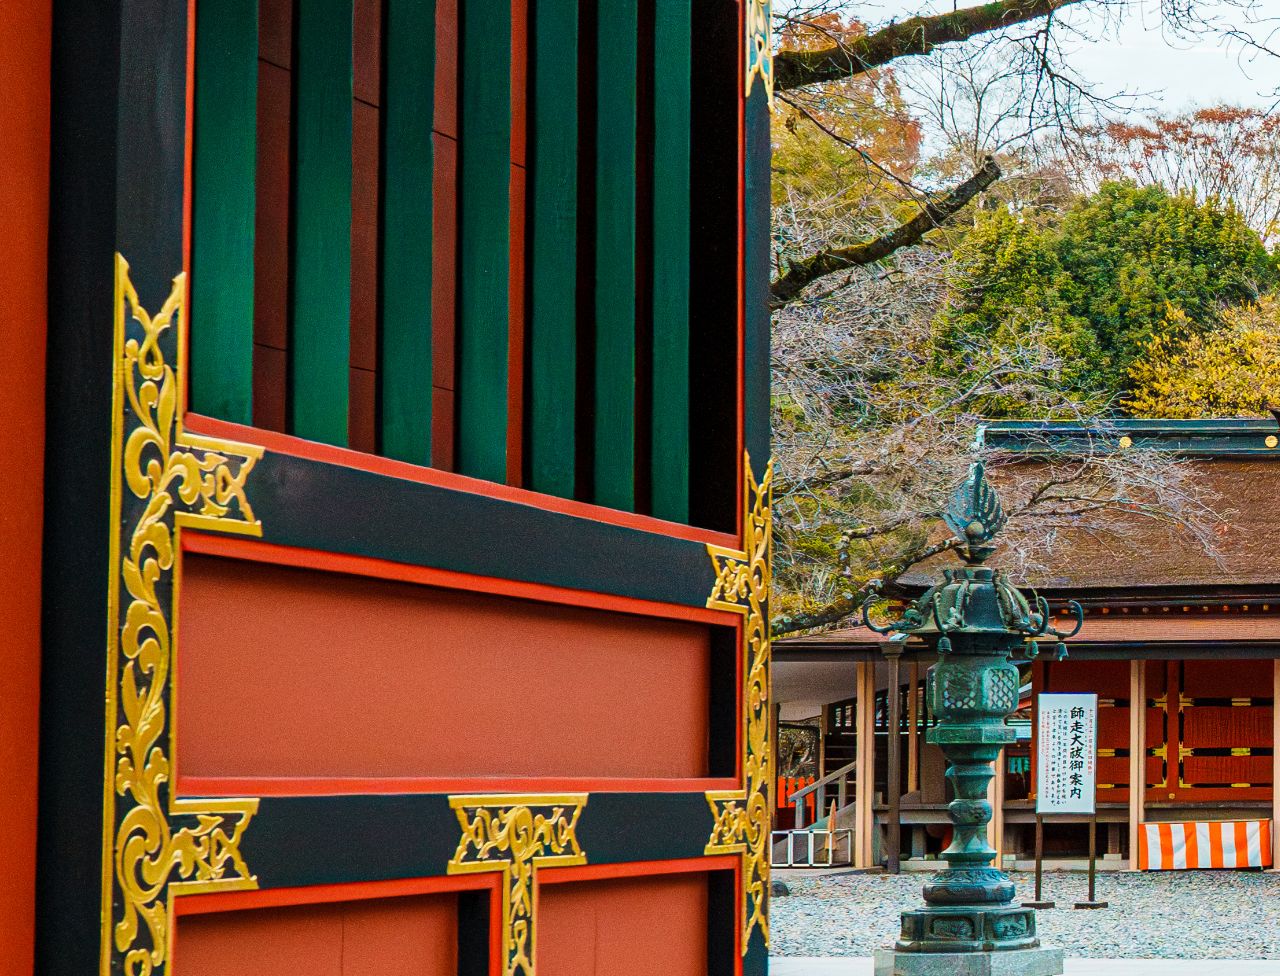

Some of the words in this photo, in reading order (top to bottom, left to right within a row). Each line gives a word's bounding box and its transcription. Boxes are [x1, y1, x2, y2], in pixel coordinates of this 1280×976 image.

[1069, 706, 1085, 800] 師走大祓御案内
